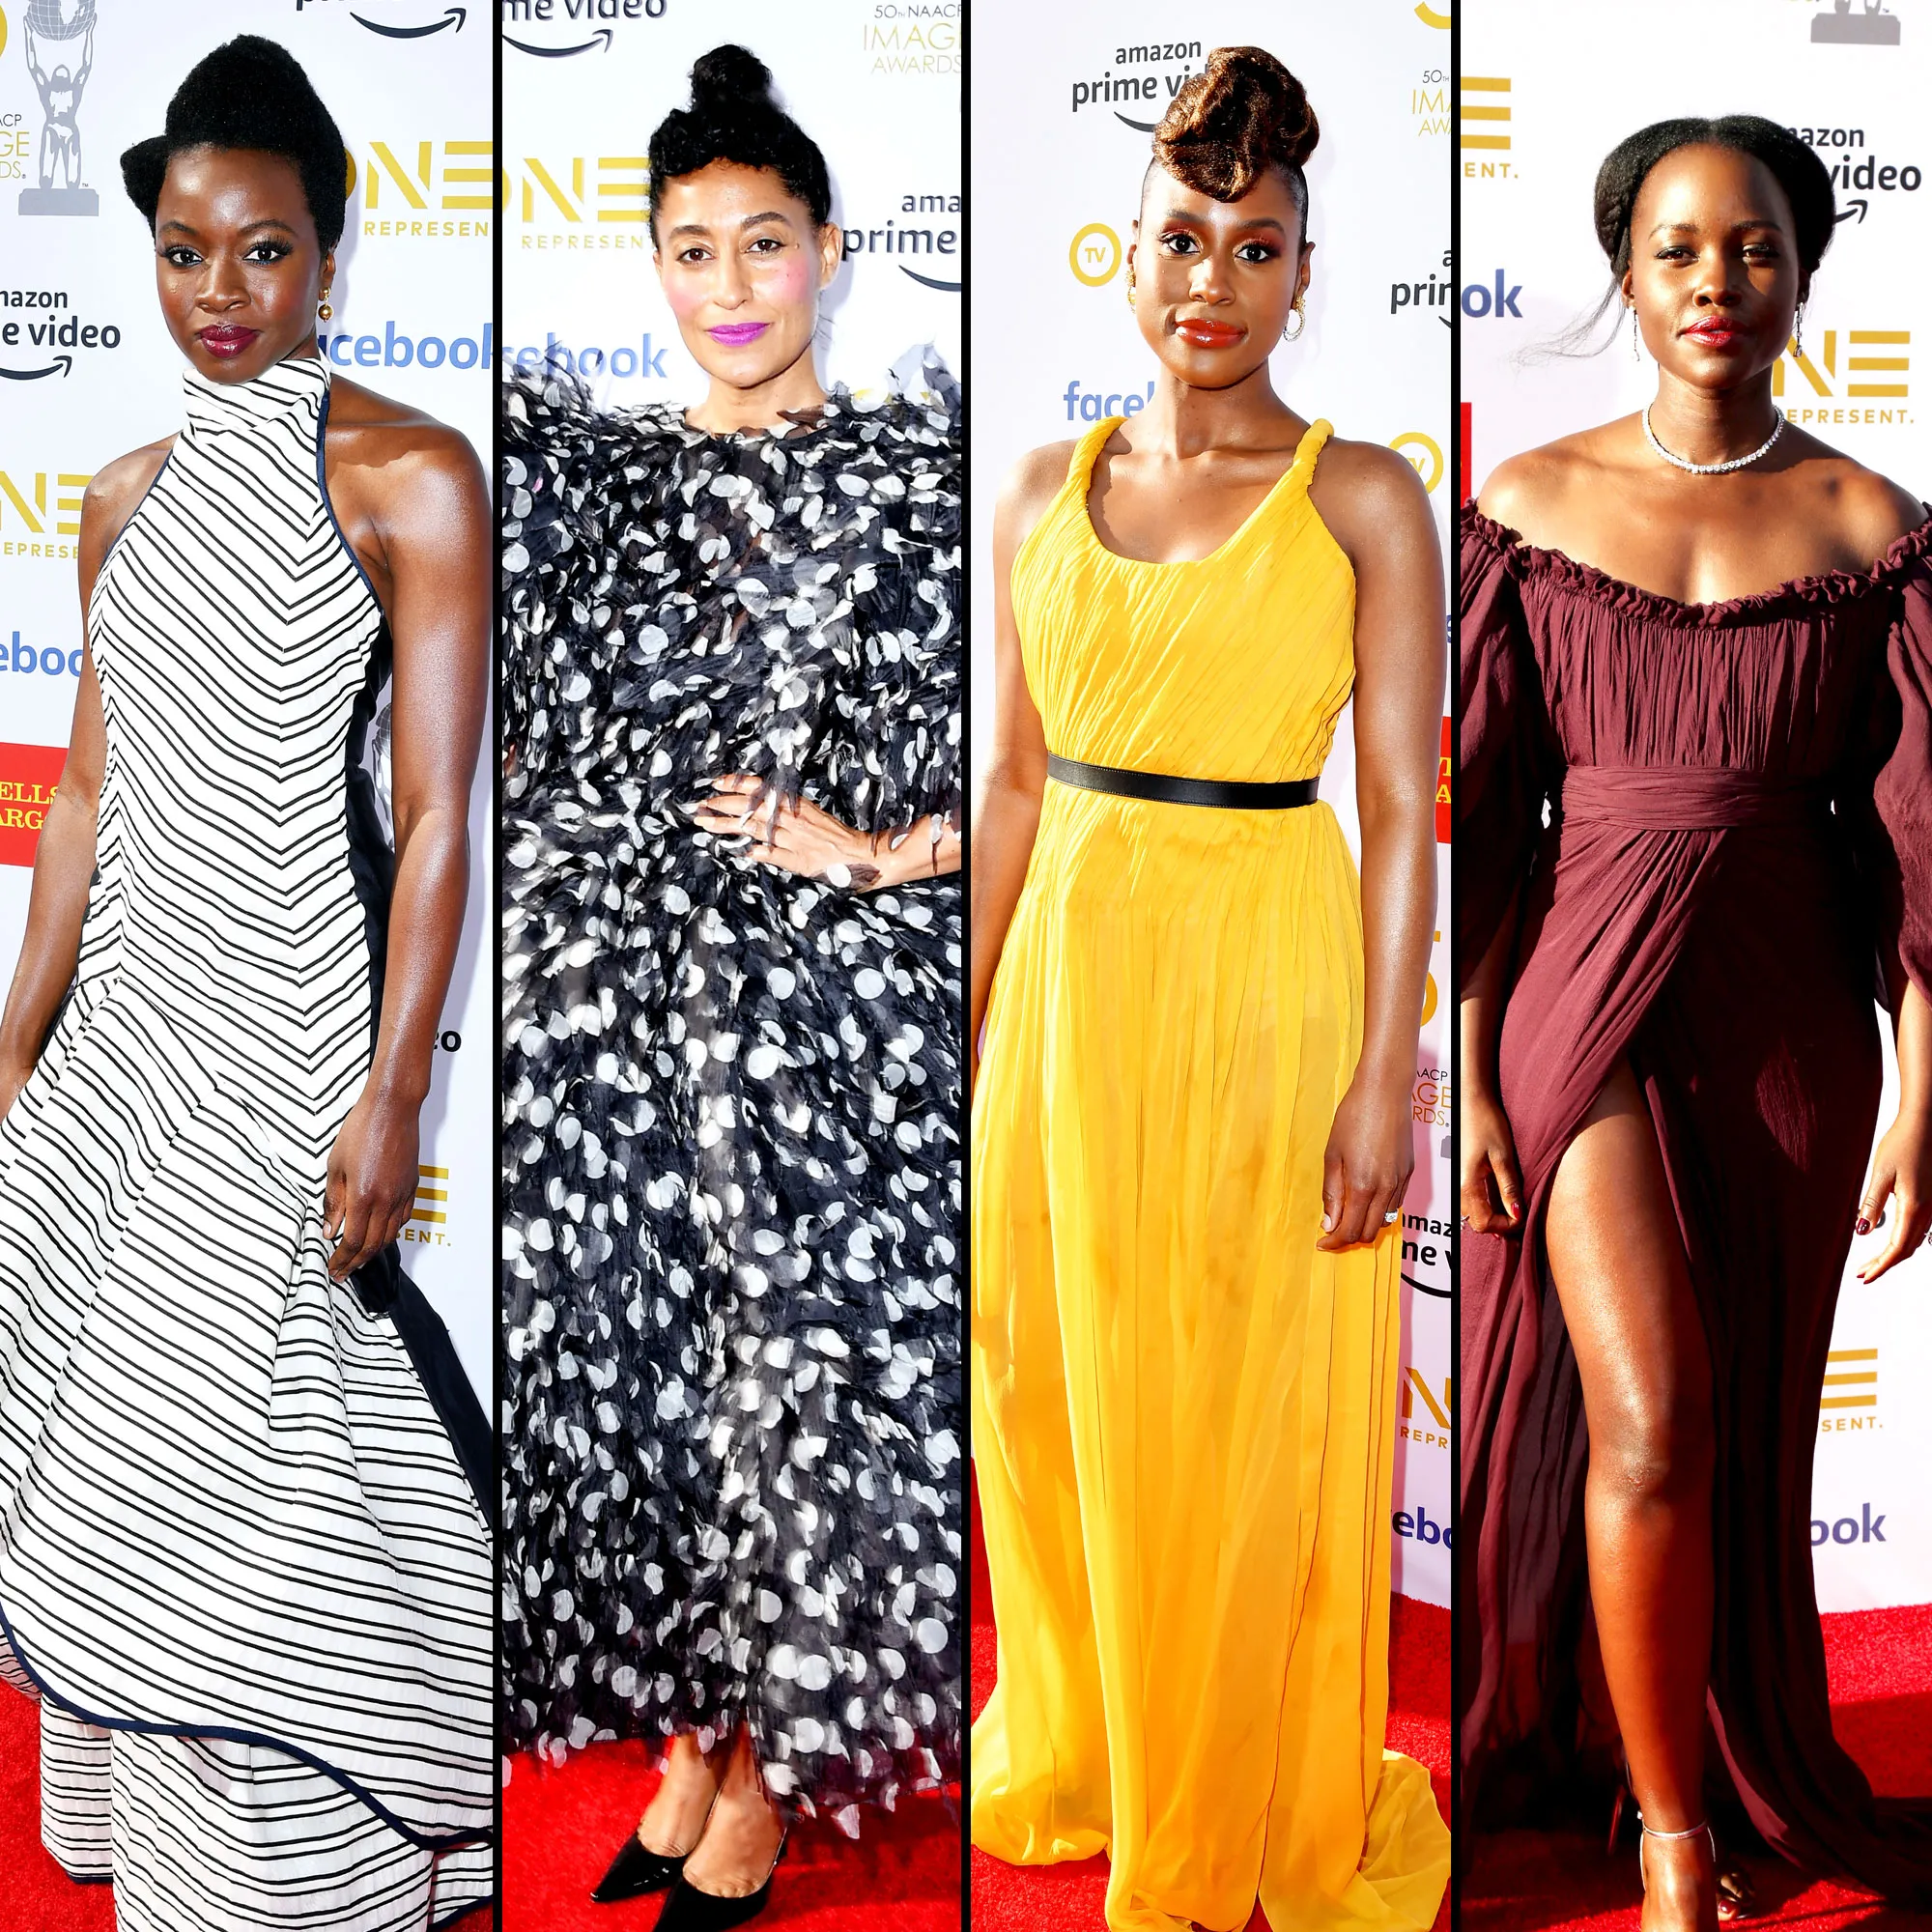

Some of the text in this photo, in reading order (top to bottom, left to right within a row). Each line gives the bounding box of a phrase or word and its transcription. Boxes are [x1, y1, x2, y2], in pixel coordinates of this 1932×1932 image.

[864, 22, 961, 50] IMAG
[1115, 41, 1202, 65] amazon
[1072, 71, 1158, 113] prime
[1412, 88, 1451, 115] IM
[1418, 117, 1451, 136] AW
[343, 140, 493, 210] NE
[502, 156, 651, 223] NE
[363, 221, 489, 237] REPRESEN
[522, 235, 654, 249] REPRESEN
[841, 219, 957, 262] prime
[1085, 246, 1106, 264] TV
[27, 314, 121, 349] video
[1411, 1082, 1451, 1109] GE
